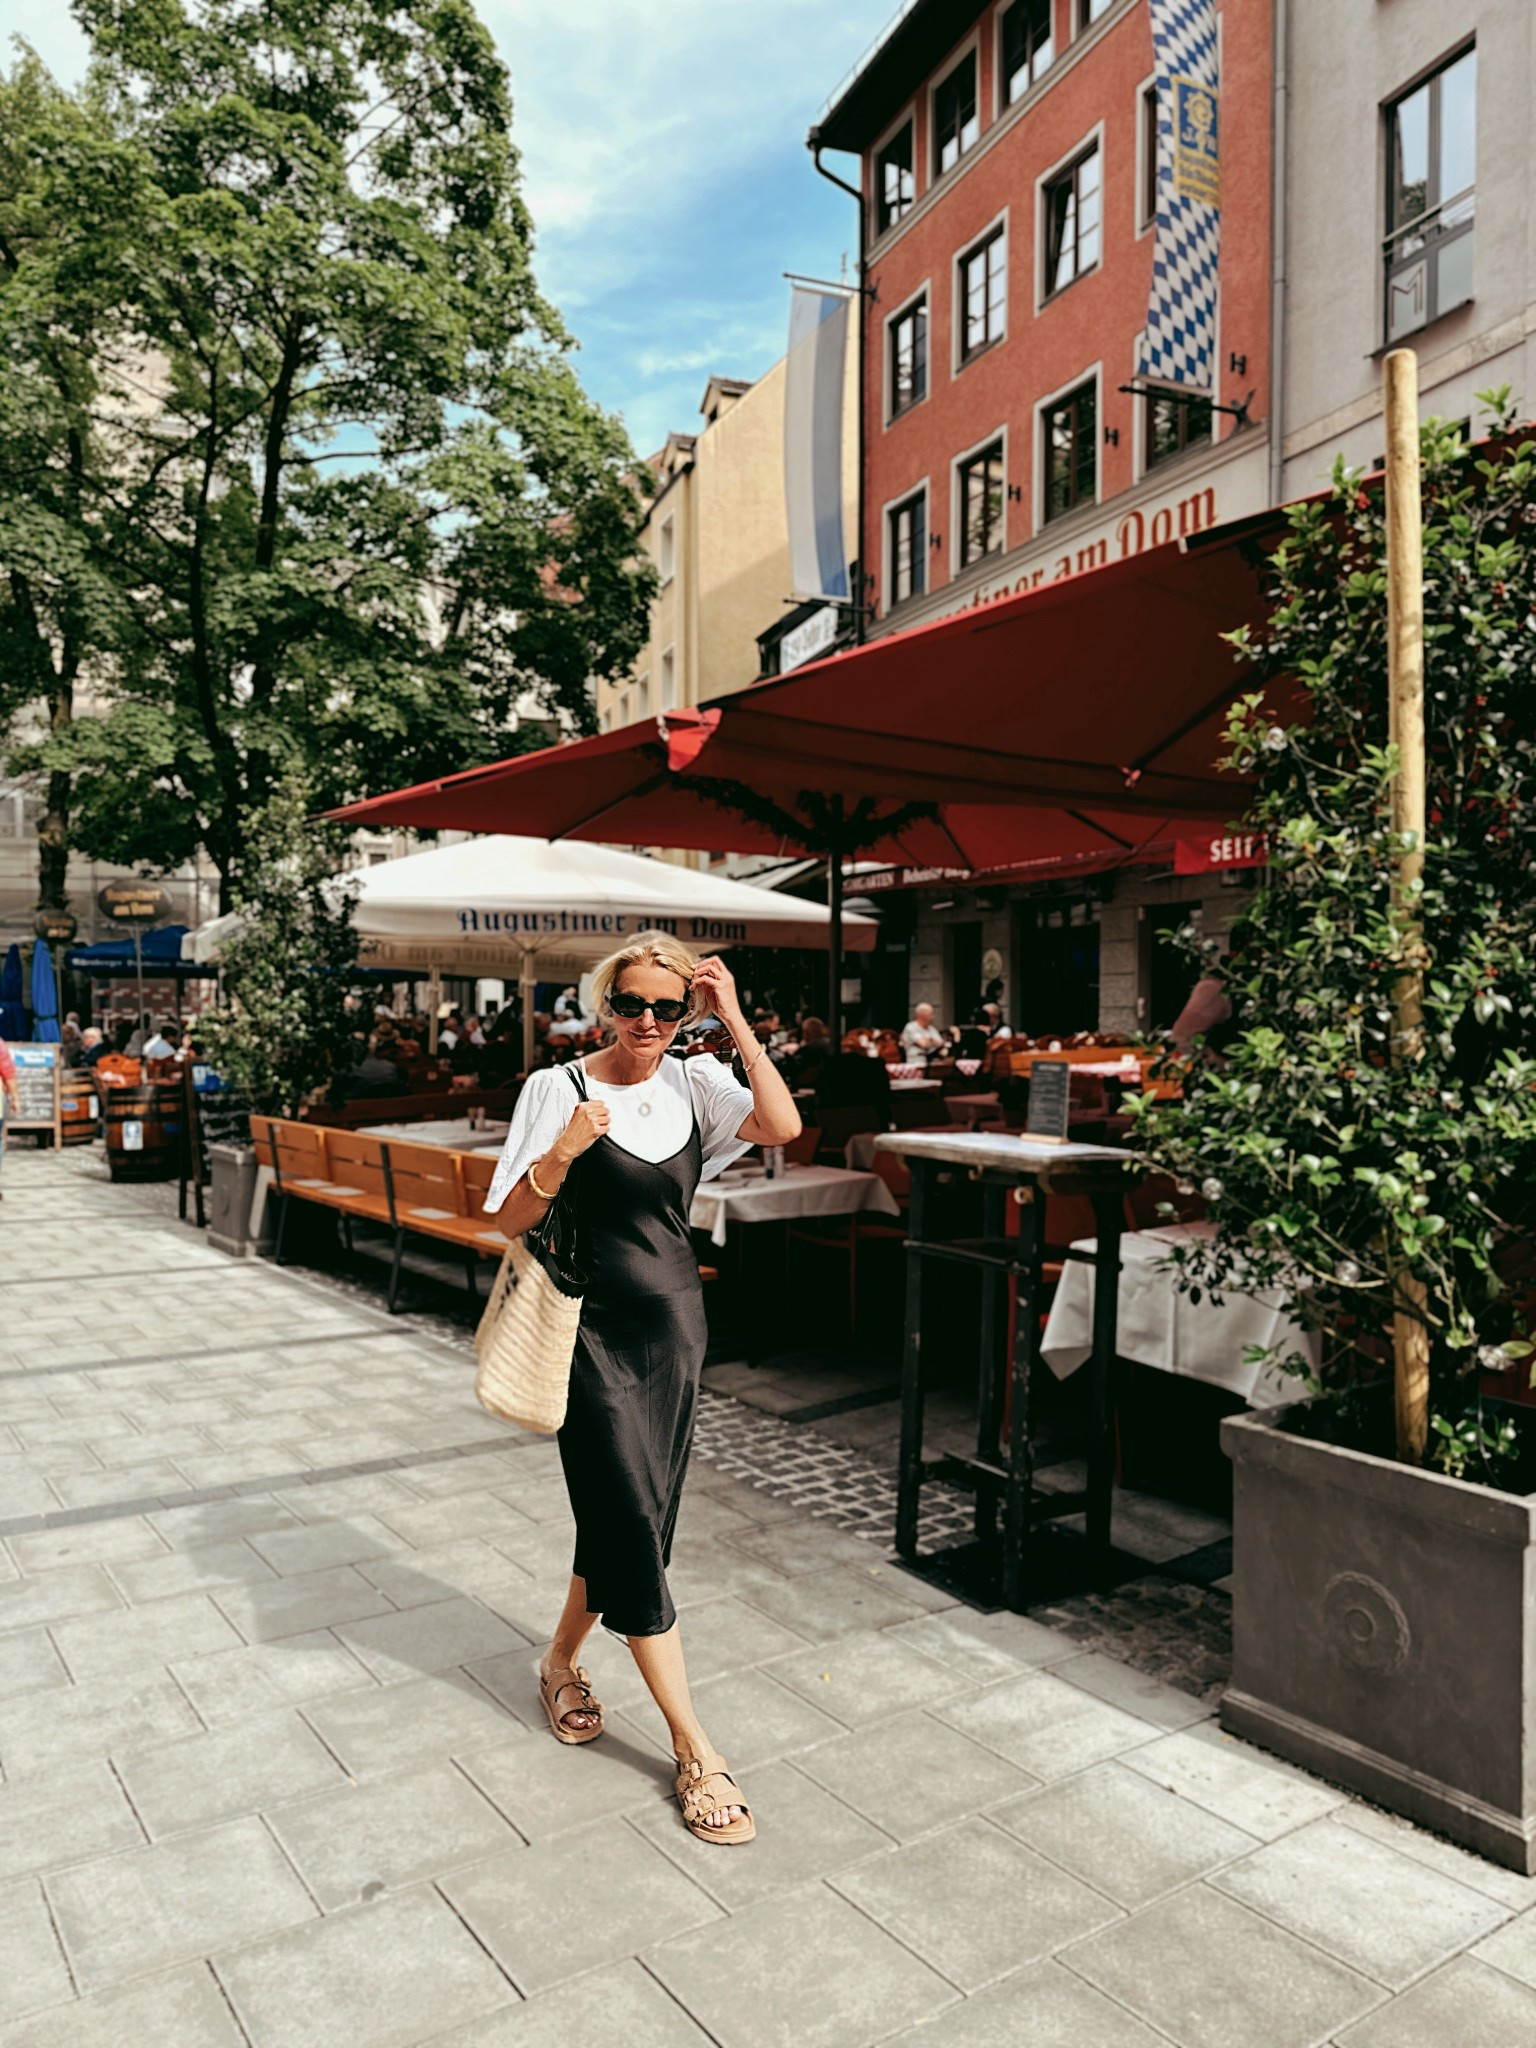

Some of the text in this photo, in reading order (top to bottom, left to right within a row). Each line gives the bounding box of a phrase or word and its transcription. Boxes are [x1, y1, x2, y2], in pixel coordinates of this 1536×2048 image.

[1055, 538, 1107, 580] am
[1116, 486, 1219, 557] Dom
[1210, 836, 1254, 863] SEIT
[457, 908, 746, 940] Augustiner am Dom
